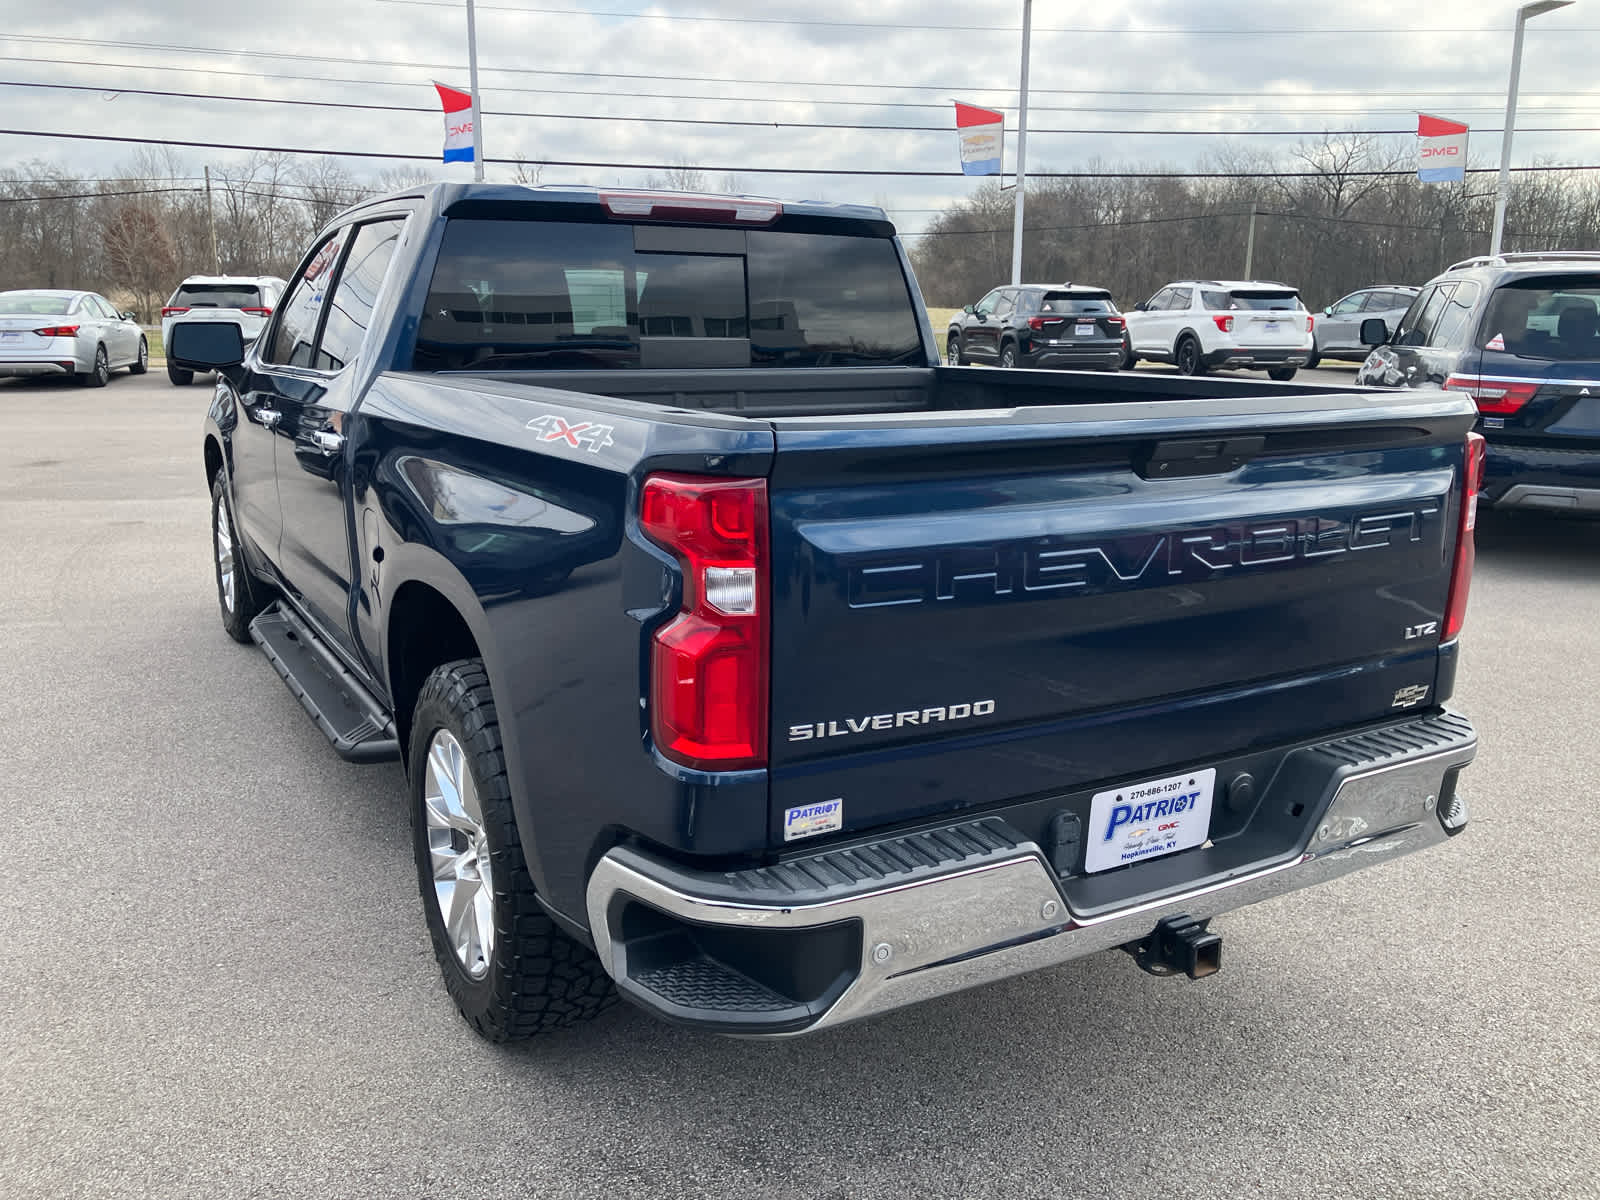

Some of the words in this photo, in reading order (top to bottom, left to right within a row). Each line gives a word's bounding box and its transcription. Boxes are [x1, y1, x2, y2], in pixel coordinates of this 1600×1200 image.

[849, 499, 1438, 608] CHEVROLET
[1404, 621, 1437, 640] LTZ
[788, 699, 995, 742] SILVERADO
[1130, 782, 1182, 800] 270-886-1207
[787, 801, 840, 826] PATRIOT
[1104, 791, 1201, 841] PATRIOT
[1157, 821, 1180, 832] GMC
[1121, 844, 1165, 860] Hopkinsville,
[1166, 840, 1177, 849] KY
